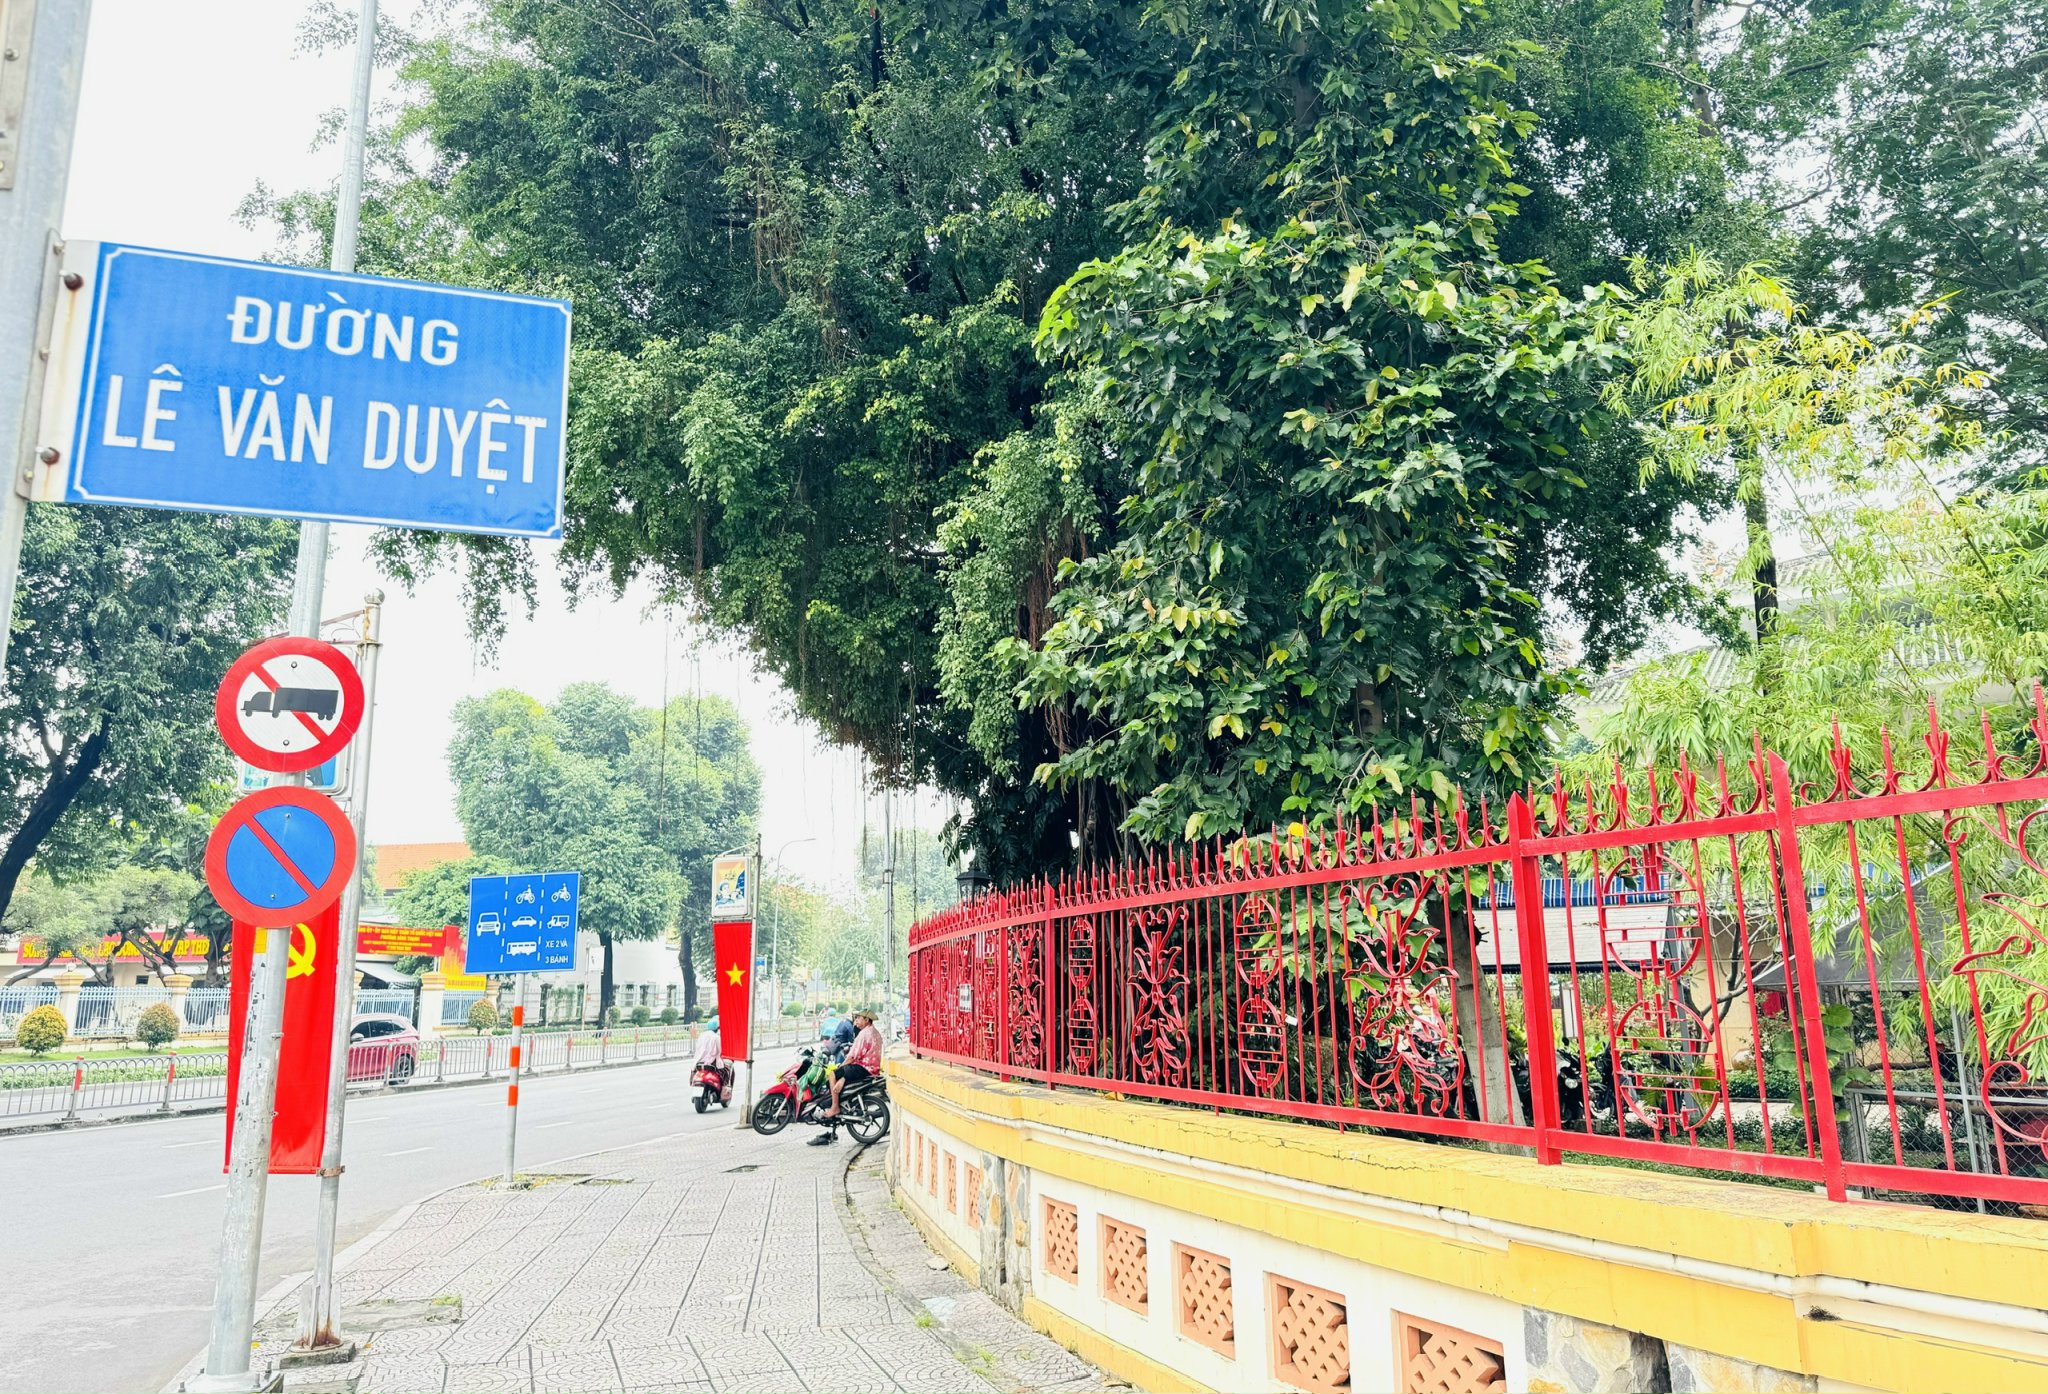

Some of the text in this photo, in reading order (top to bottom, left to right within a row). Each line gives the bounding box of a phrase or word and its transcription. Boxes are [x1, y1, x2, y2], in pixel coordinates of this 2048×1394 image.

[227, 291, 459, 366] ĐƯỜNG
[102, 363, 547, 494] LÊ VĂN DUYỆT
[545, 940, 555, 948] XE
[555, 940, 560, 948] 2
[545, 953, 569, 964] 3 BÁNH
